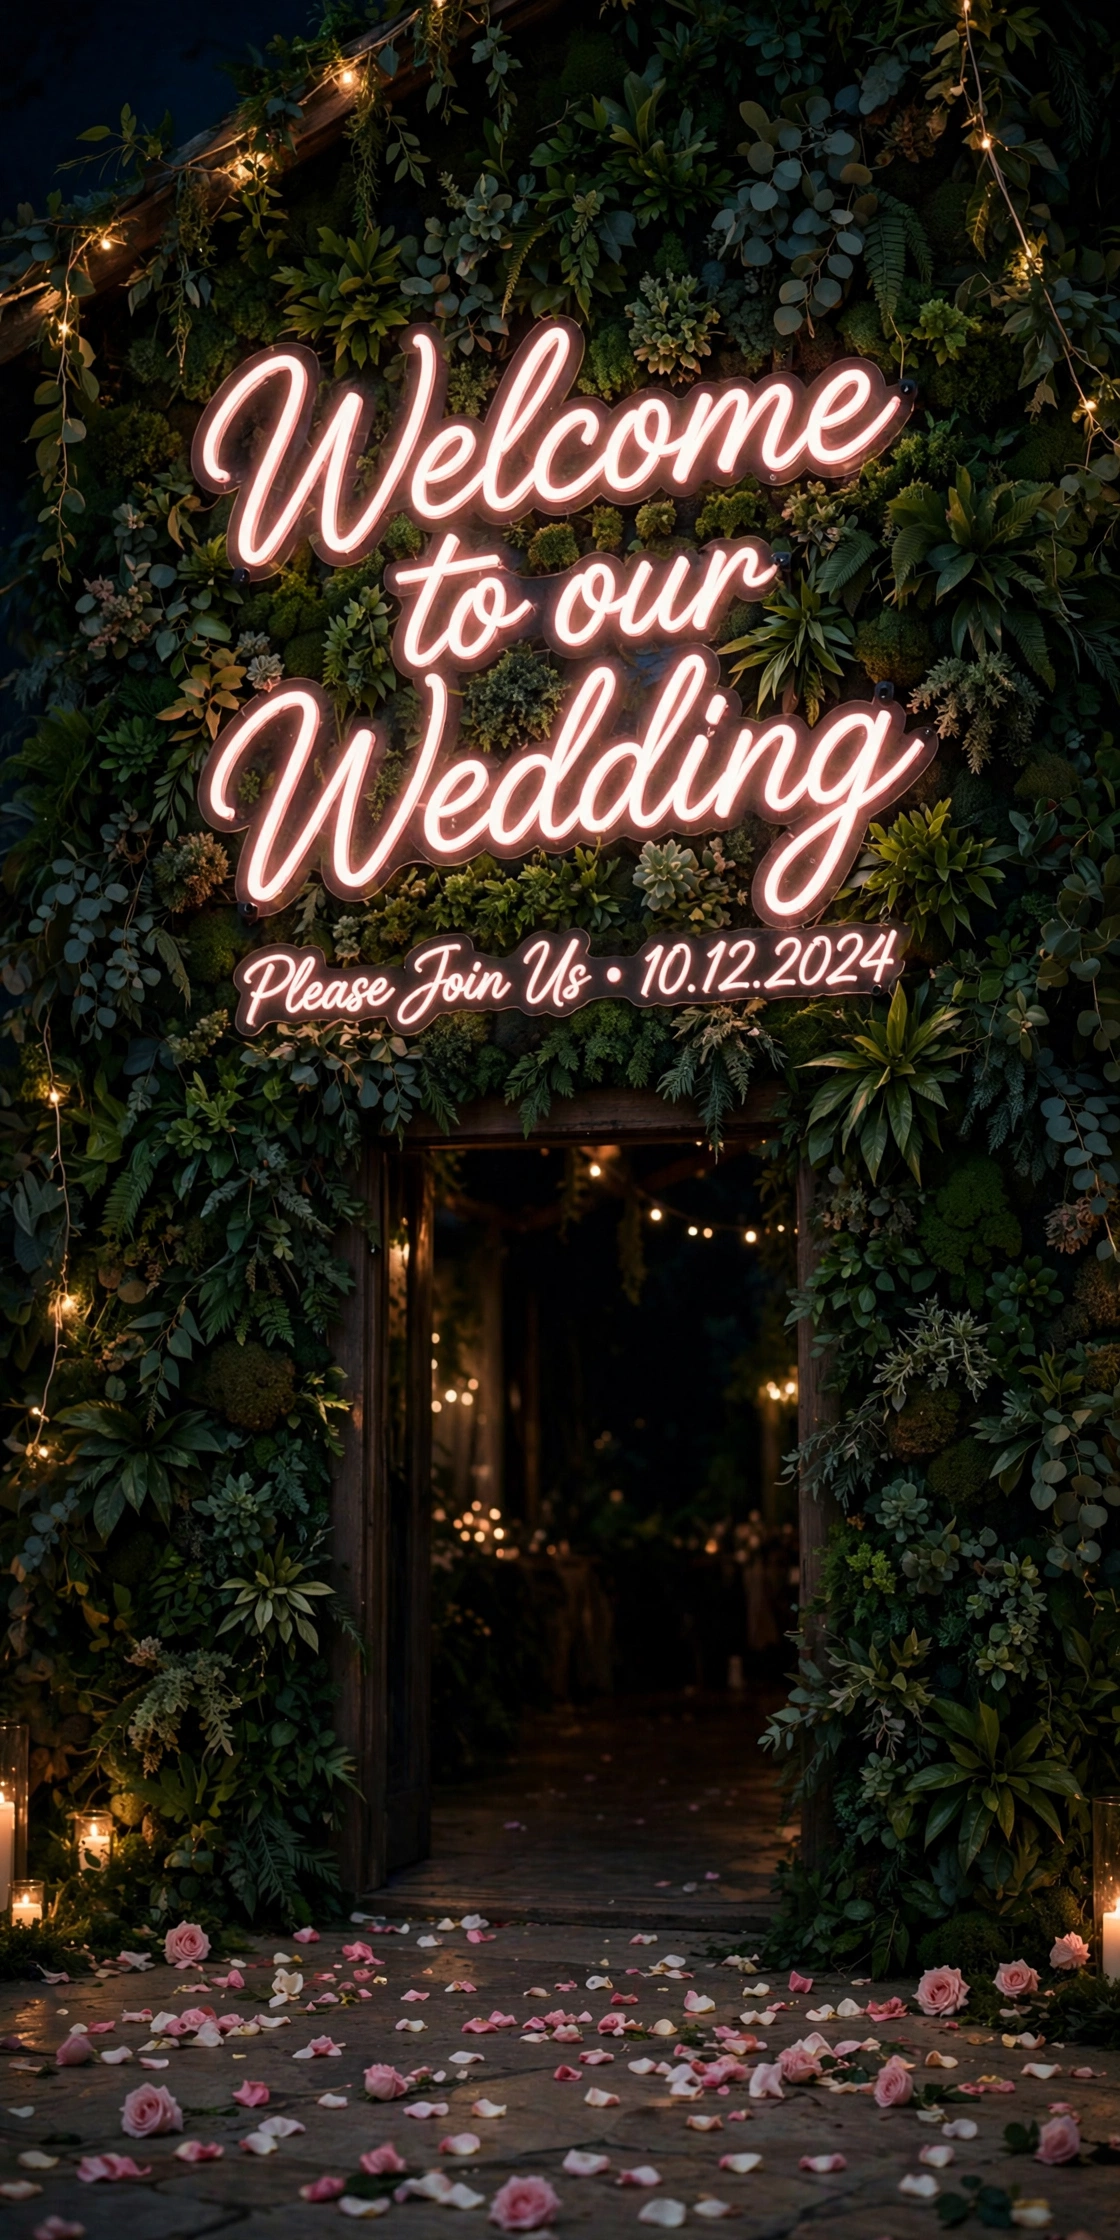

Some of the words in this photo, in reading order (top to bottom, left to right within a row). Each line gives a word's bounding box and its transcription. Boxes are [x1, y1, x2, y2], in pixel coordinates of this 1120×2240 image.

[202, 326, 903, 567] Welcome
[394, 532, 534, 669] to
[553, 545, 778, 648] our
[208, 652, 926, 916] Wedding
[243, 953, 396, 1026] Please
[396, 942, 512, 1026] Join
[523, 937, 593, 1008] Us
[639, 928, 898, 999] 10.12.2024
